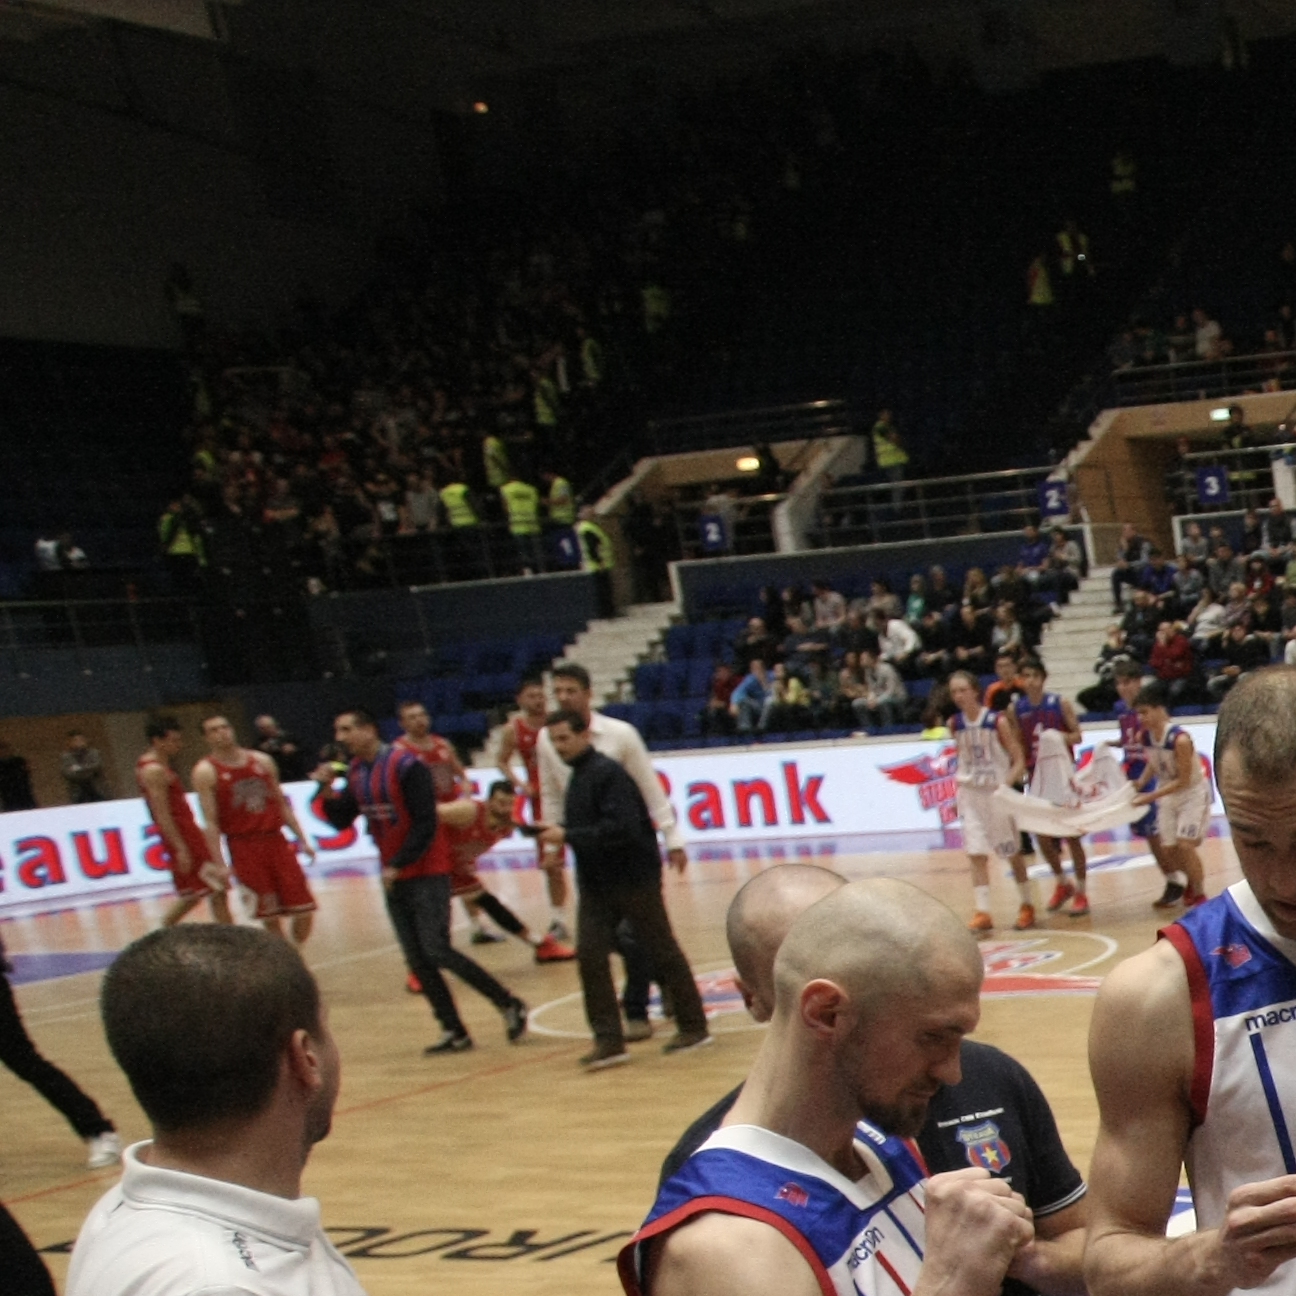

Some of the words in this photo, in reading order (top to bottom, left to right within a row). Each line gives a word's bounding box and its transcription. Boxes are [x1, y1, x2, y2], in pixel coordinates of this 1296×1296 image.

[1205, 476, 1220, 496] 3
[1046, 489, 1062, 508] 2
[705, 522, 722, 543] 2
